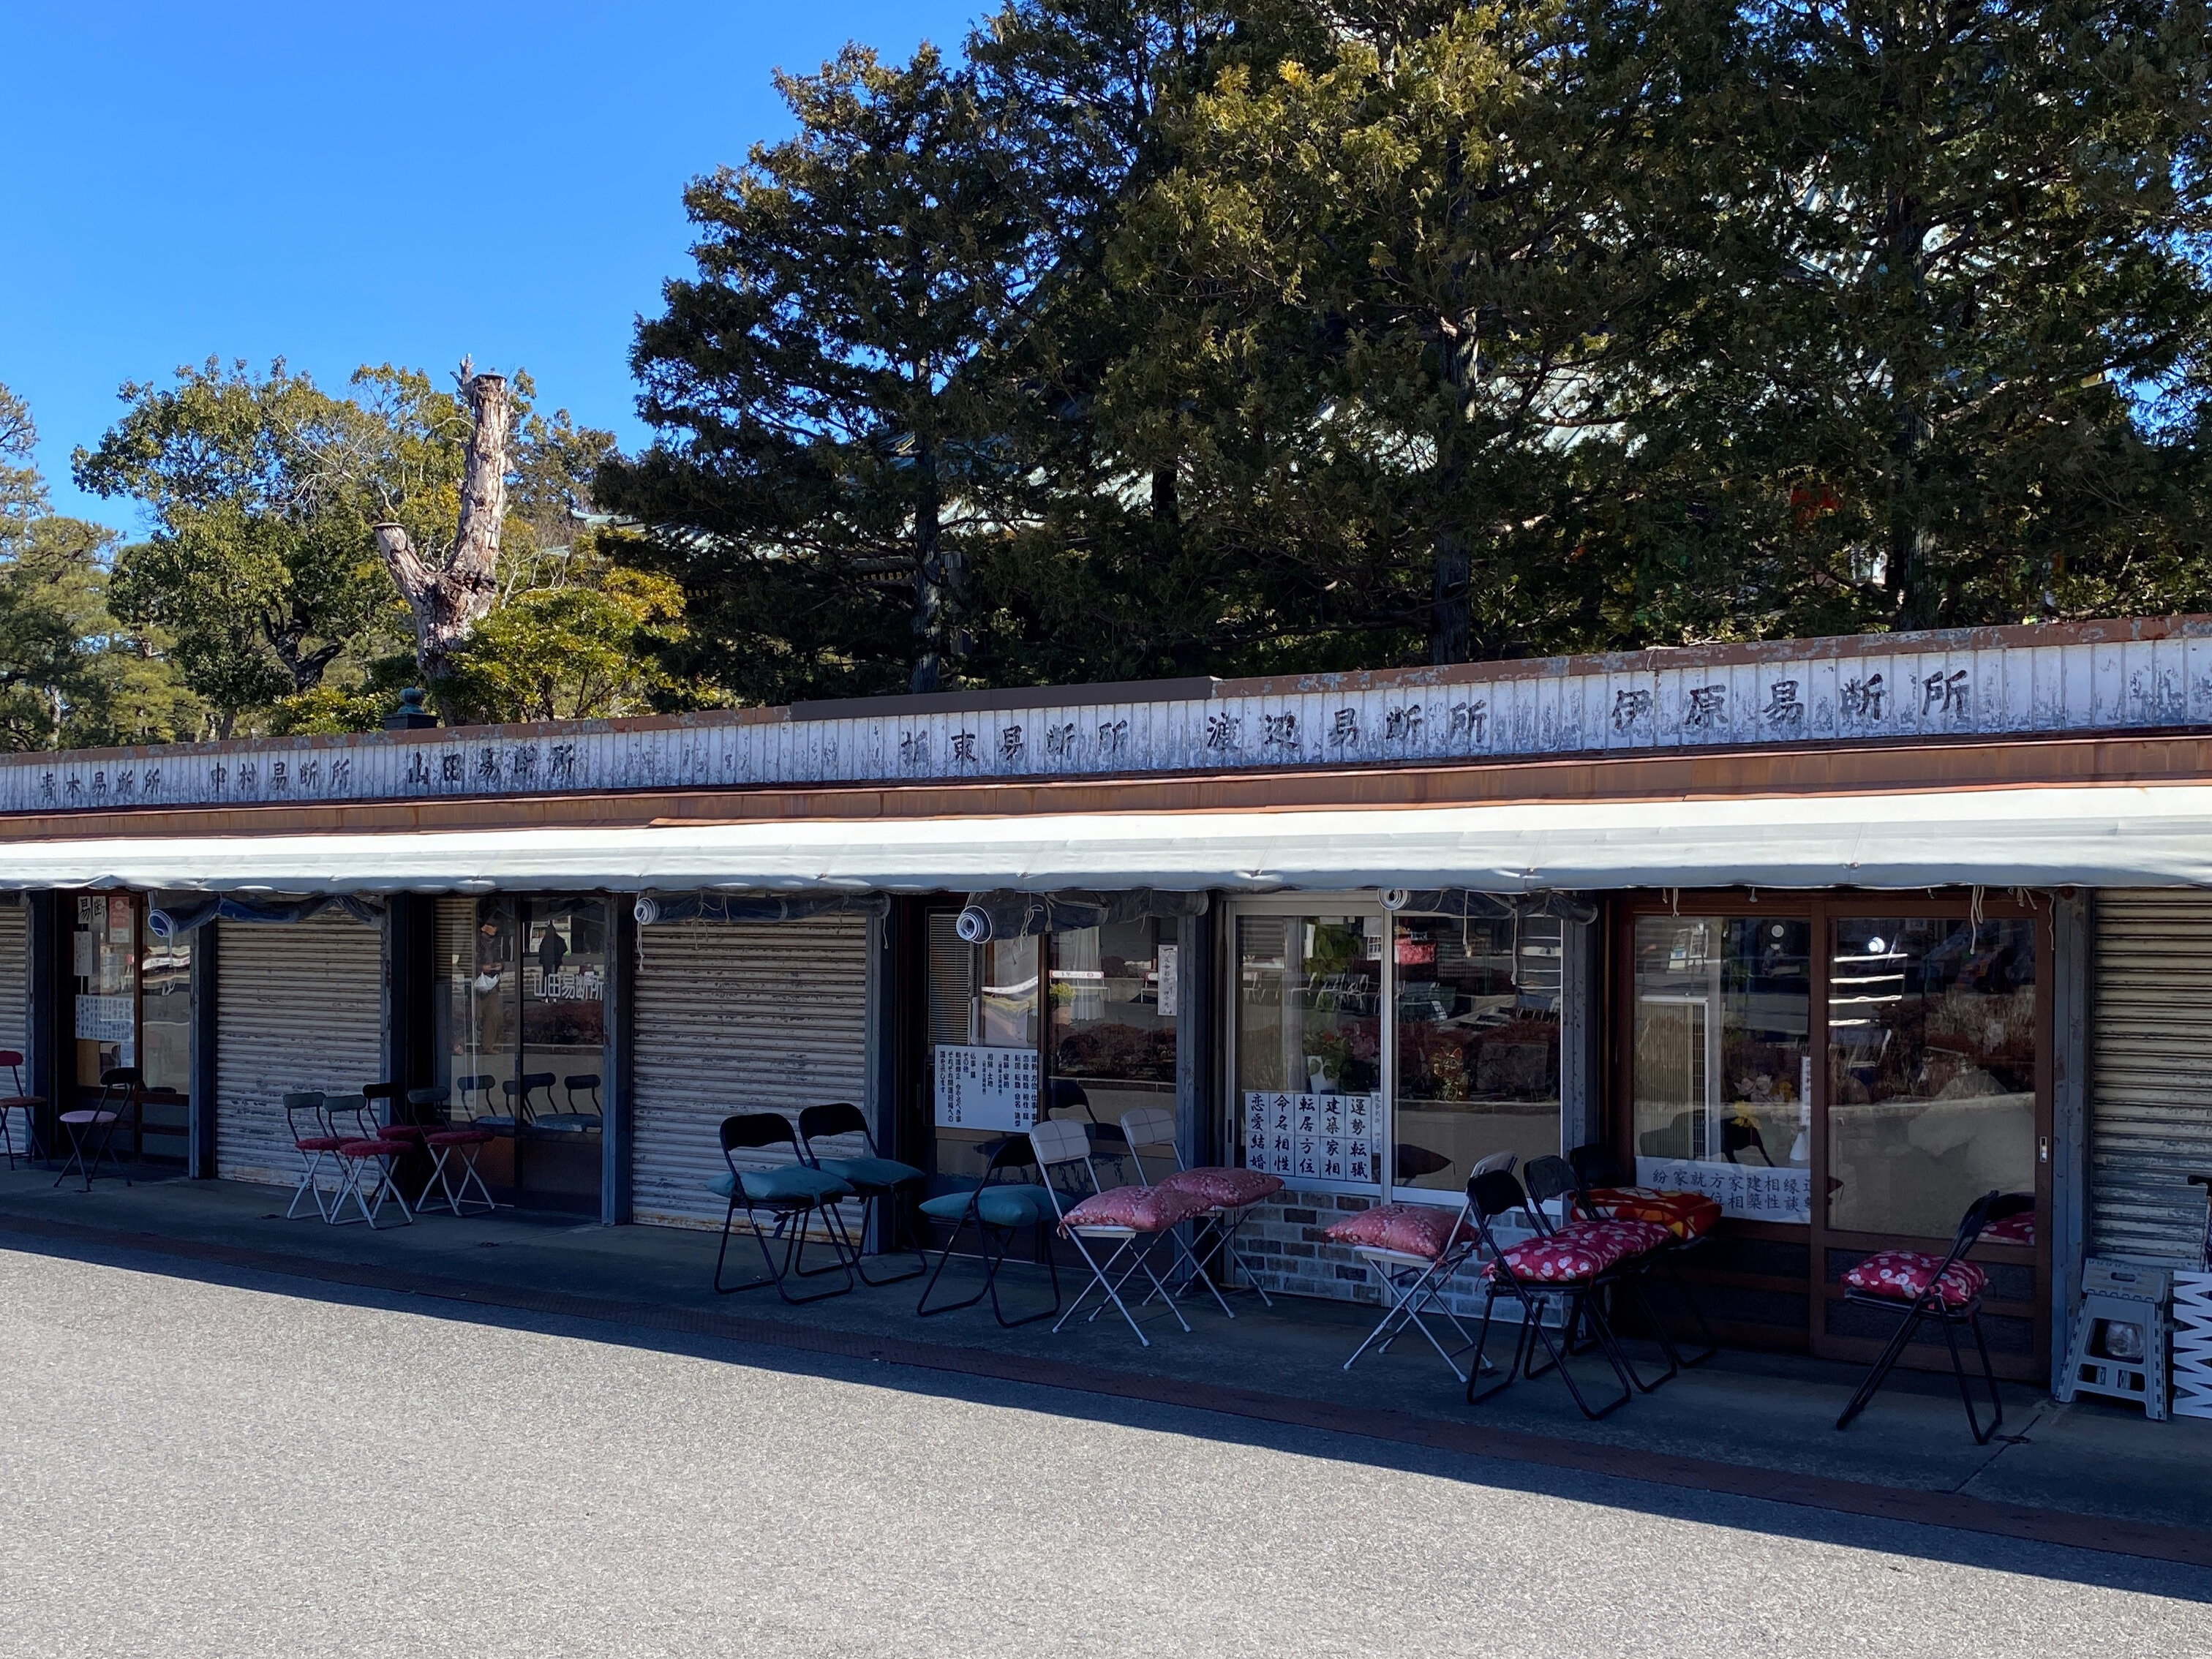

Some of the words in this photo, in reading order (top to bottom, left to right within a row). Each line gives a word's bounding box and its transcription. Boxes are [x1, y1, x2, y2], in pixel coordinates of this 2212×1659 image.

[1611, 669, 1968, 729] 伊原易断所
[41, 768, 160, 802] 青木易断所
[211, 758, 350, 792] 中村易断所
[534, 973, 604, 1001] 山田易断所
[1249, 1094, 1266, 1170] 恋愛結婚
[1274, 1094, 1290, 1172] 命名相性
[1298, 1096, 1316, 1174] 転居方位
[1324, 1096, 1342, 1175] 建築家相
[1728, 1174, 1744, 1209] 家相
[1747, 1175, 1764, 1209] 建築
[1764, 1178, 1780, 1209] 相性
[1783, 1178, 1800, 1212] 縁談
